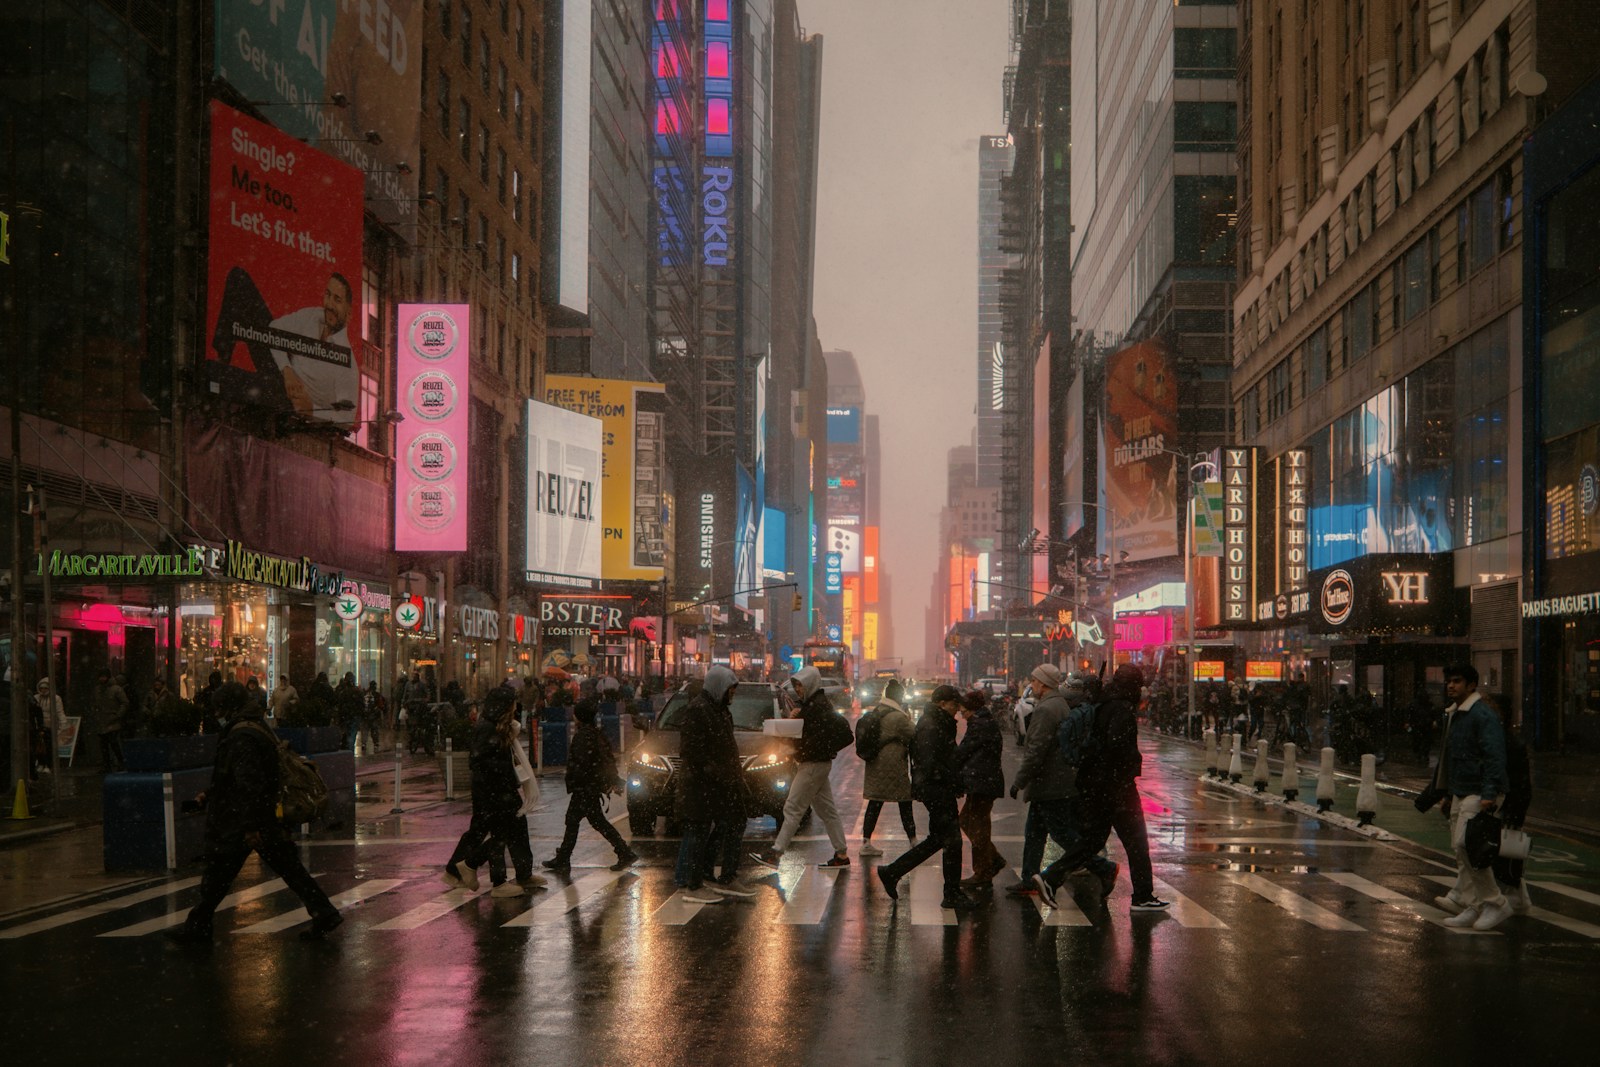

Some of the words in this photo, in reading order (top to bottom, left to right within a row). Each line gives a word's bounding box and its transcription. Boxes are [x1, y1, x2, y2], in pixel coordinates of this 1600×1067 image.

[239, 27, 268, 80] Get
[274, 62, 298, 108] the
[231, 127, 296, 175] Single?
[231, 164, 261, 195] Me
[264, 182, 298, 213] too.
[230, 201, 272, 239] Let's
[274, 219, 296, 249] fix
[298, 231, 336, 263] that.
[703, 166, 733, 265] ROKU
[232, 321, 348, 363] findmohamedawife.com
[423, 321, 444, 330] REUZEL
[422, 381, 443, 390] REUZEL
[579, 390, 601, 403] THE
[588, 403, 625, 417] FROM
[421, 442, 443, 451] REUZEL
[1114, 433, 1164, 466] DOLLARS
[701, 493, 714, 568] SAMSUNG
[37, 548, 203, 576] MARGARITAVILLE
[227, 539, 310, 591] MARGARITAVILLE
[1381, 571, 1429, 604] YH
[1522, 599, 1551, 618] PARIS
[1551, 592, 1600, 616] BAGUETT
[462, 604, 499, 641] GIFTS
[547, 627, 591, 636] LOBSTER
